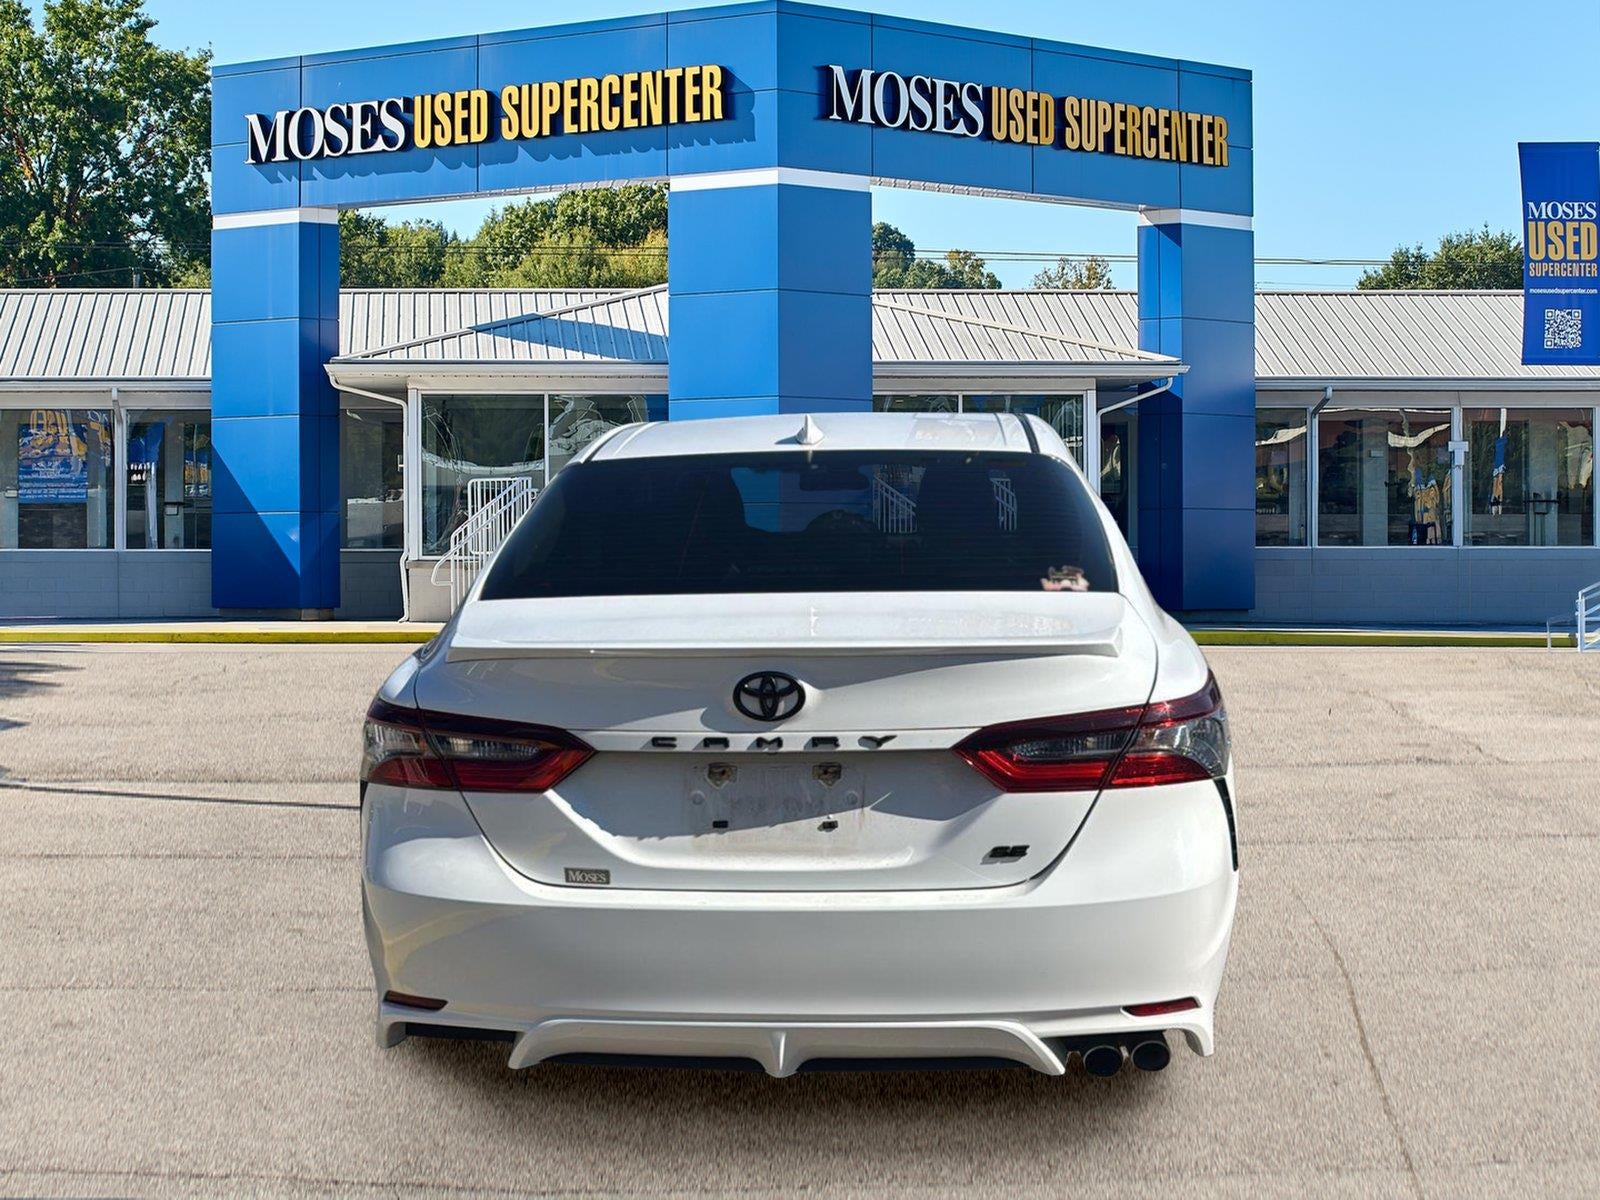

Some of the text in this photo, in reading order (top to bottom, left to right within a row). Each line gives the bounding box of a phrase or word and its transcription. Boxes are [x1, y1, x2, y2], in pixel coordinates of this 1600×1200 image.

[244, 64, 726, 164] MOSES USED SUPERCENTER
[827, 64, 1229, 167] MOSES USED SUPERCENTER
[1527, 201, 1597, 220] MOSES
[1528, 221, 1598, 261] USED
[1529, 262, 1598, 277] SUPERCENTER
[651, 734, 897, 748] CAMRY
[567, 870, 606, 883] MOSES
